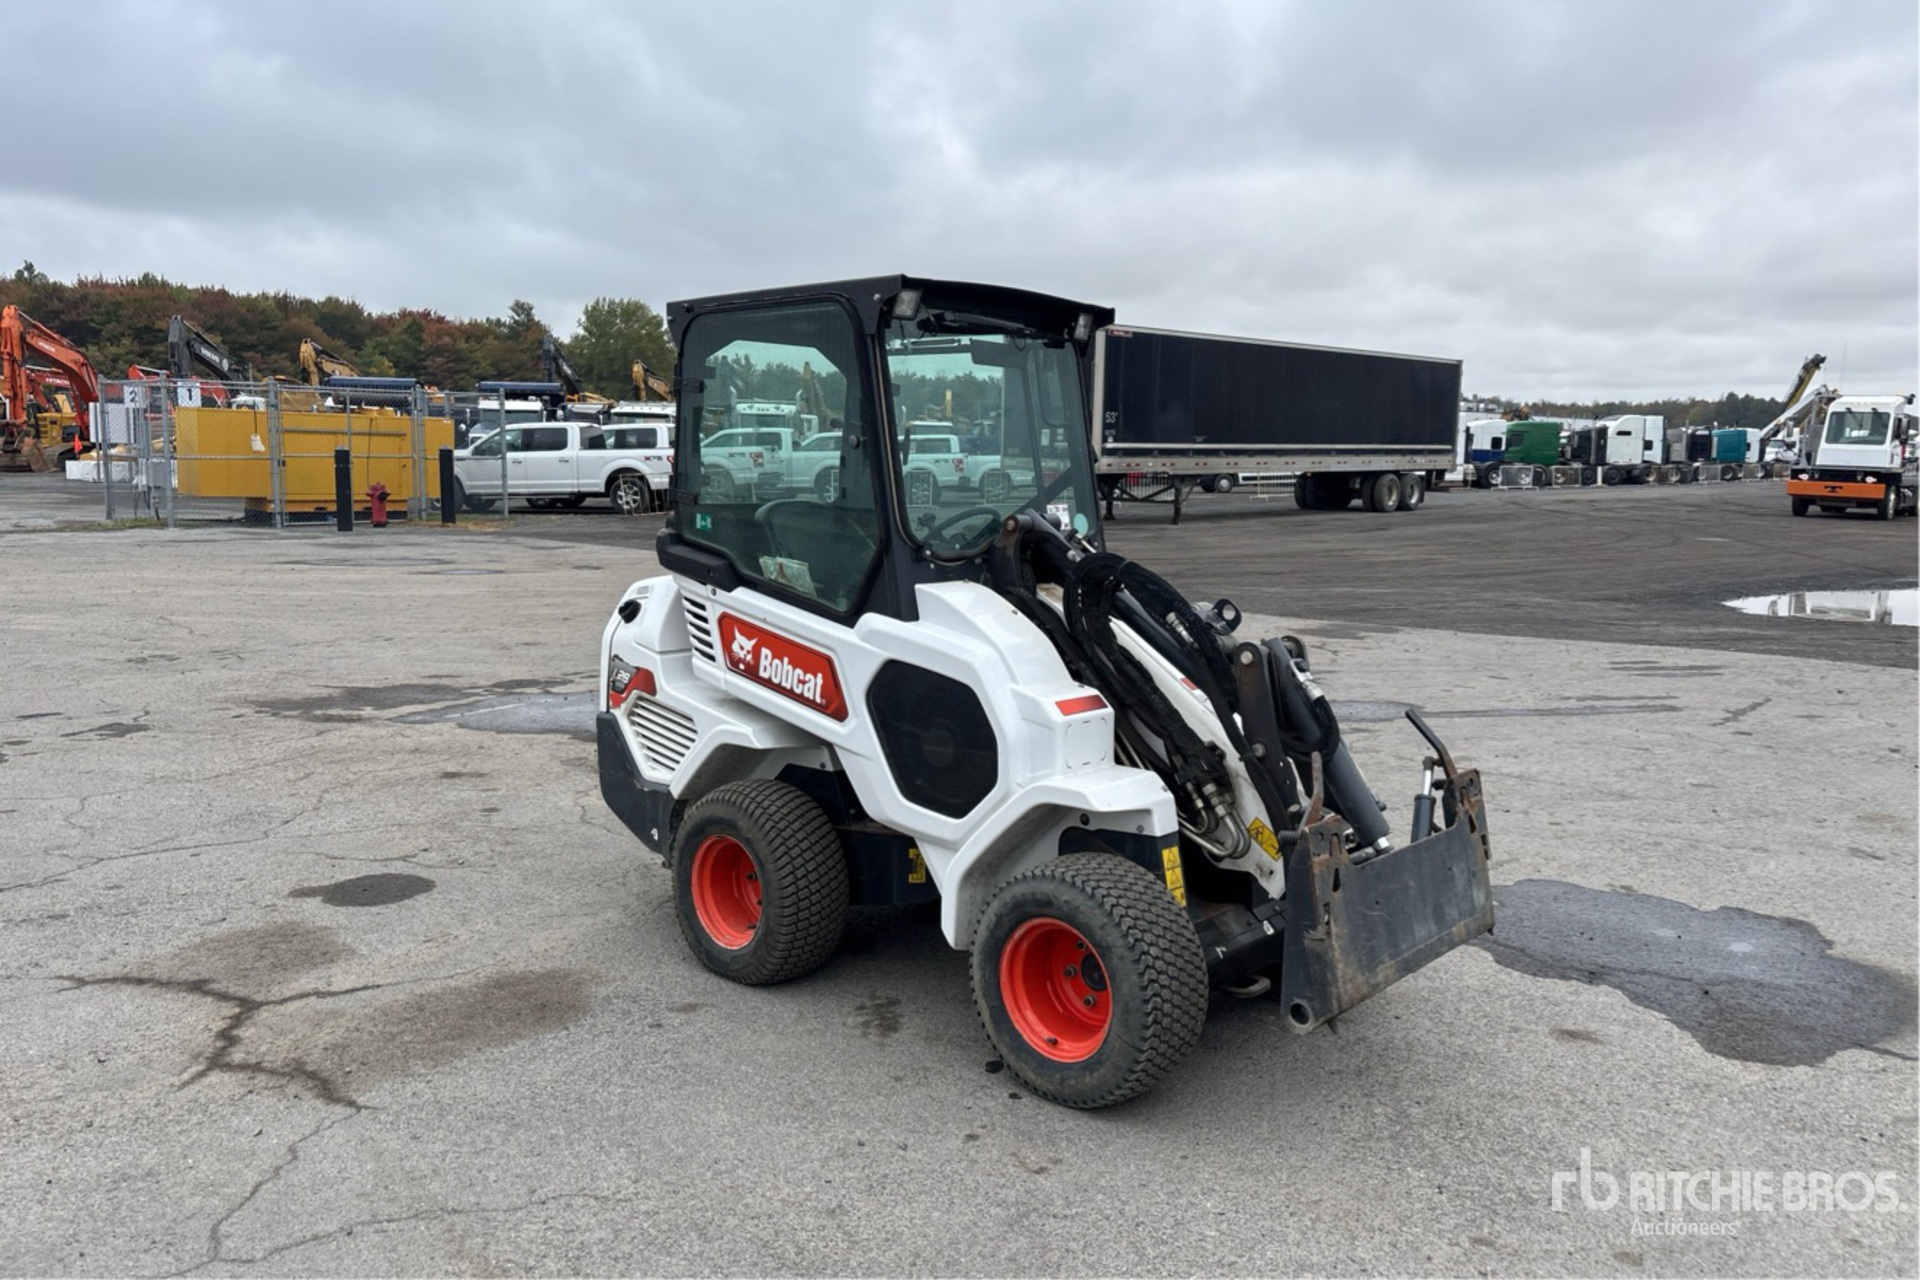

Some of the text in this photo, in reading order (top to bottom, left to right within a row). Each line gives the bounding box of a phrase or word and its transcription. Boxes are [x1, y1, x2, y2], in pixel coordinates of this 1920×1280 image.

[129, 389, 139, 403] 2
[186, 388, 193, 402] 1
[1105, 411, 1118, 424] 53'
[758, 646, 824, 704] Bobcat
